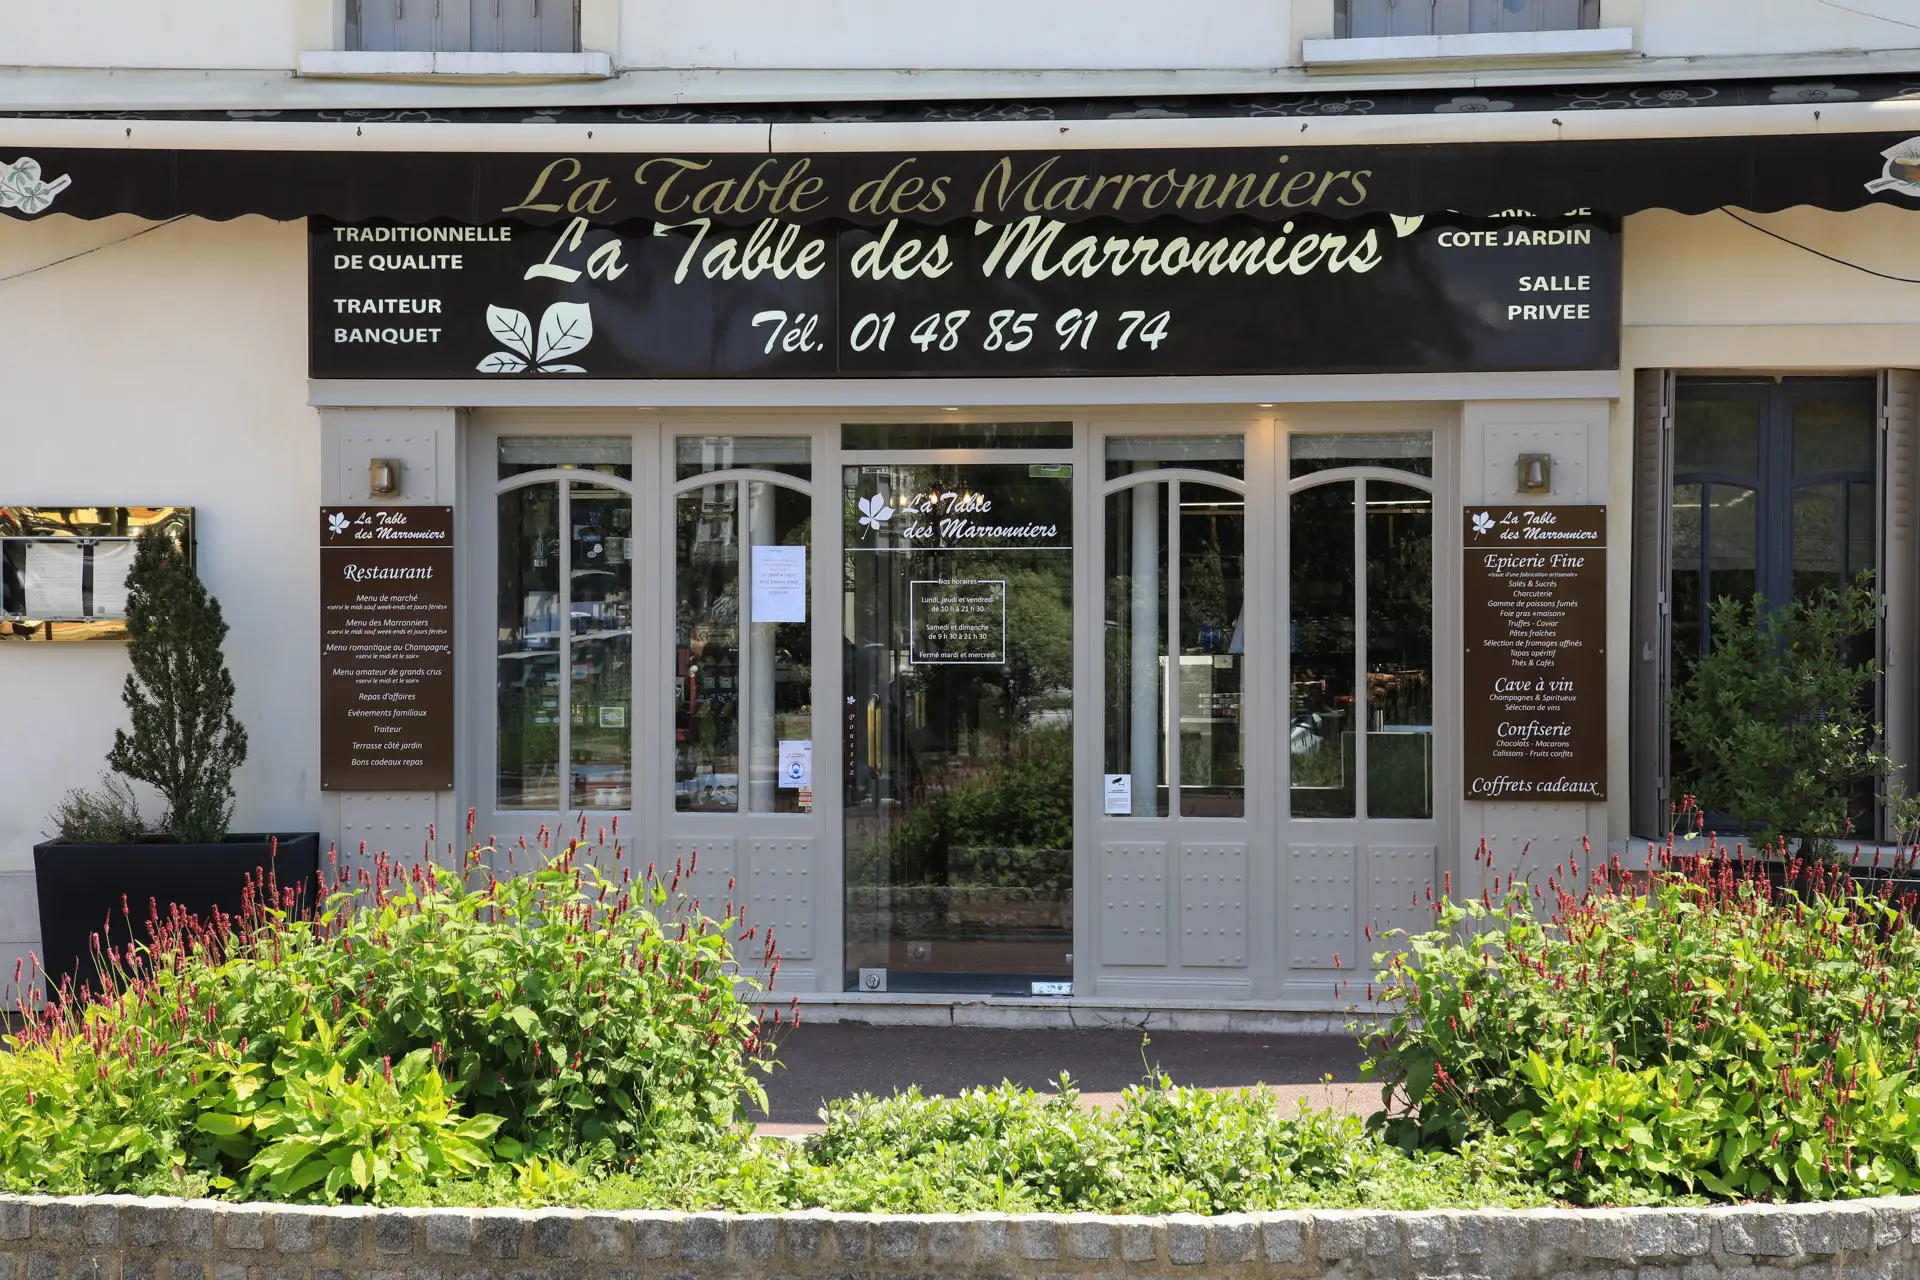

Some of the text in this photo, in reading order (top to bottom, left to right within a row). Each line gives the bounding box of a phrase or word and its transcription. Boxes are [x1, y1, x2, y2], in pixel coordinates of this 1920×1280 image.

[502, 154, 1372, 215] La Table des Marronniers
[333, 227, 511, 242] TRADITIONNELLE
[1438, 230, 1590, 247] COTE JARDIN
[523, 215, 1382, 284] La Table des Marronniers
[334, 255, 463, 271] DE QUALITE
[1519, 276, 1590, 291] SALLE
[333, 299, 441, 313] TRAITEUR
[1508, 304, 1590, 320] PRIVEE
[334, 328, 441, 344] BANQUET
[751, 308, 1171, 354] Tél. 01 48 85 91 74
[902, 491, 991, 514] La Table
[354, 512, 407, 524] La Table
[1500, 511, 1556, 525] La Table
[355, 527, 445, 539] des Marronniers
[904, 518, 1057, 538] des Marronniers
[1500, 527, 1598, 540] des Marronniers
[1484, 554, 1584, 572] Epicerie Fine
[344, 564, 433, 582] Restaurant
[1556, 600, 1578, 608] fumés
[349, 644, 391, 653] romantique
[404, 644, 448, 653] Champagne
[1524, 640, 1558, 648] fromages
[1559, 640, 1582, 648] affinés
[400, 669, 425, 677] grands
[1495, 677, 1573, 692] Cave à vin
[359, 693, 380, 701] Repas
[393, 709, 427, 718] familiaux
[1498, 720, 1571, 740] Confiserie
[401, 742, 422, 750] jardin
[1472, 776, 1600, 796] Coffrets cadeaux
